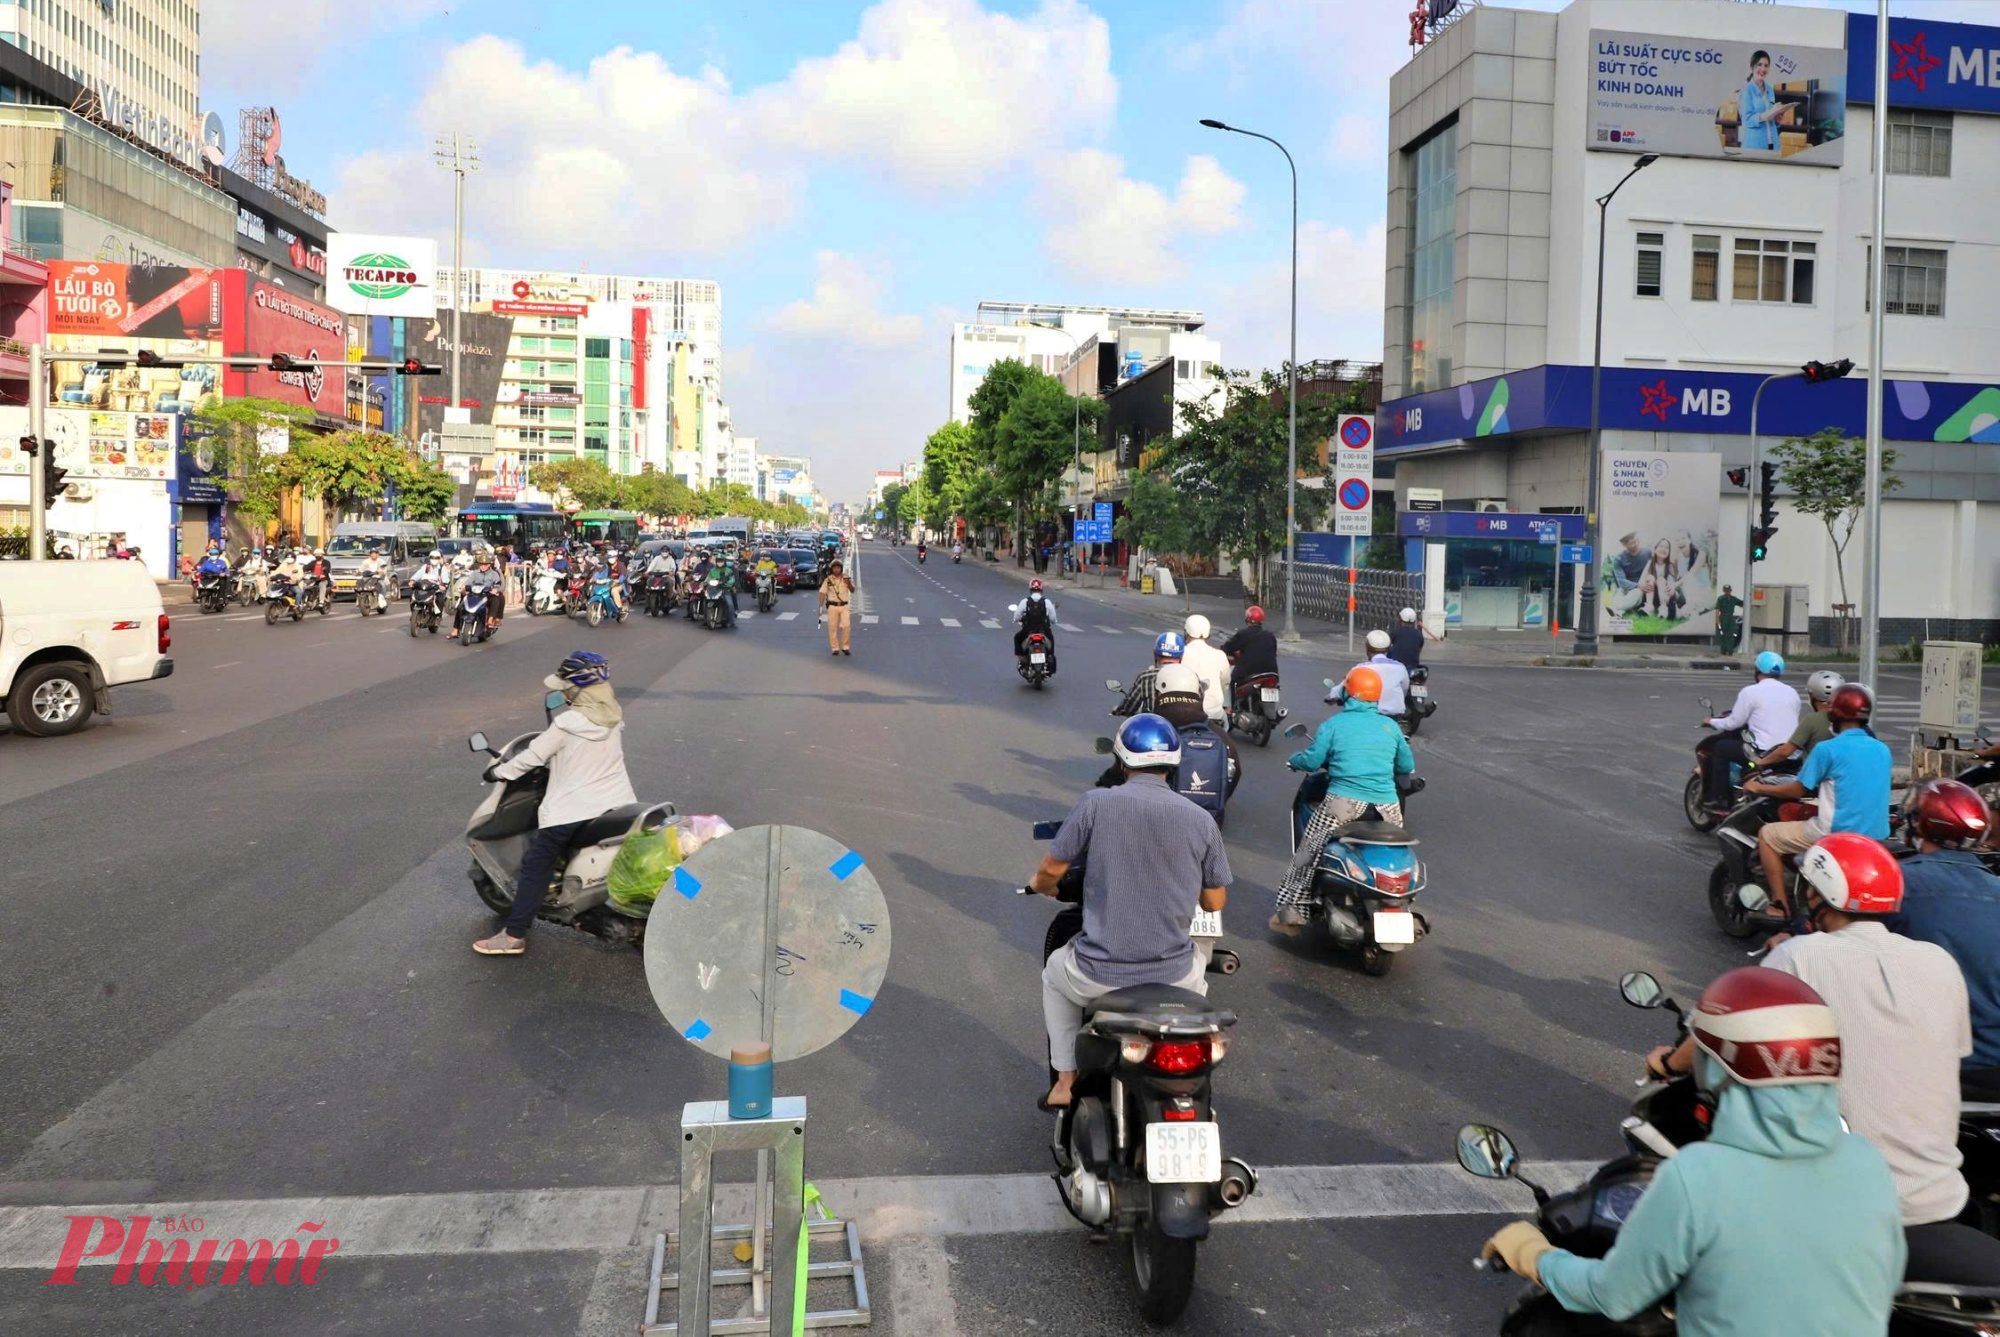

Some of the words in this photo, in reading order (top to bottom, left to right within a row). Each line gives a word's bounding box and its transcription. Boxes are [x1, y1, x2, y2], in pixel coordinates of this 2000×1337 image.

[1598, 41, 1620, 56] LÃI
[1623, 43, 1658, 59] SUẤT
[1661, 48, 1691, 64] CỰC
[1695, 48, 1723, 65] SỐC
[1598, 59, 1626, 75] BỨT
[1629, 61, 1658, 77] TỐC
[1598, 79, 1630, 93] KINH
[1634, 82, 1684, 98] DOANH
[55, 273, 86, 294] LẨU
[92, 277, 115, 297] BÒ
[343, 267, 417, 284] TECAPRO
[55, 295, 97, 313] TƯƠI
[1682, 388, 1731, 416] MB
[1405, 408, 1422, 432] MB
[1490, 520, 1507, 530] MB
[1158, 1127, 1207, 1150] 55-P6
